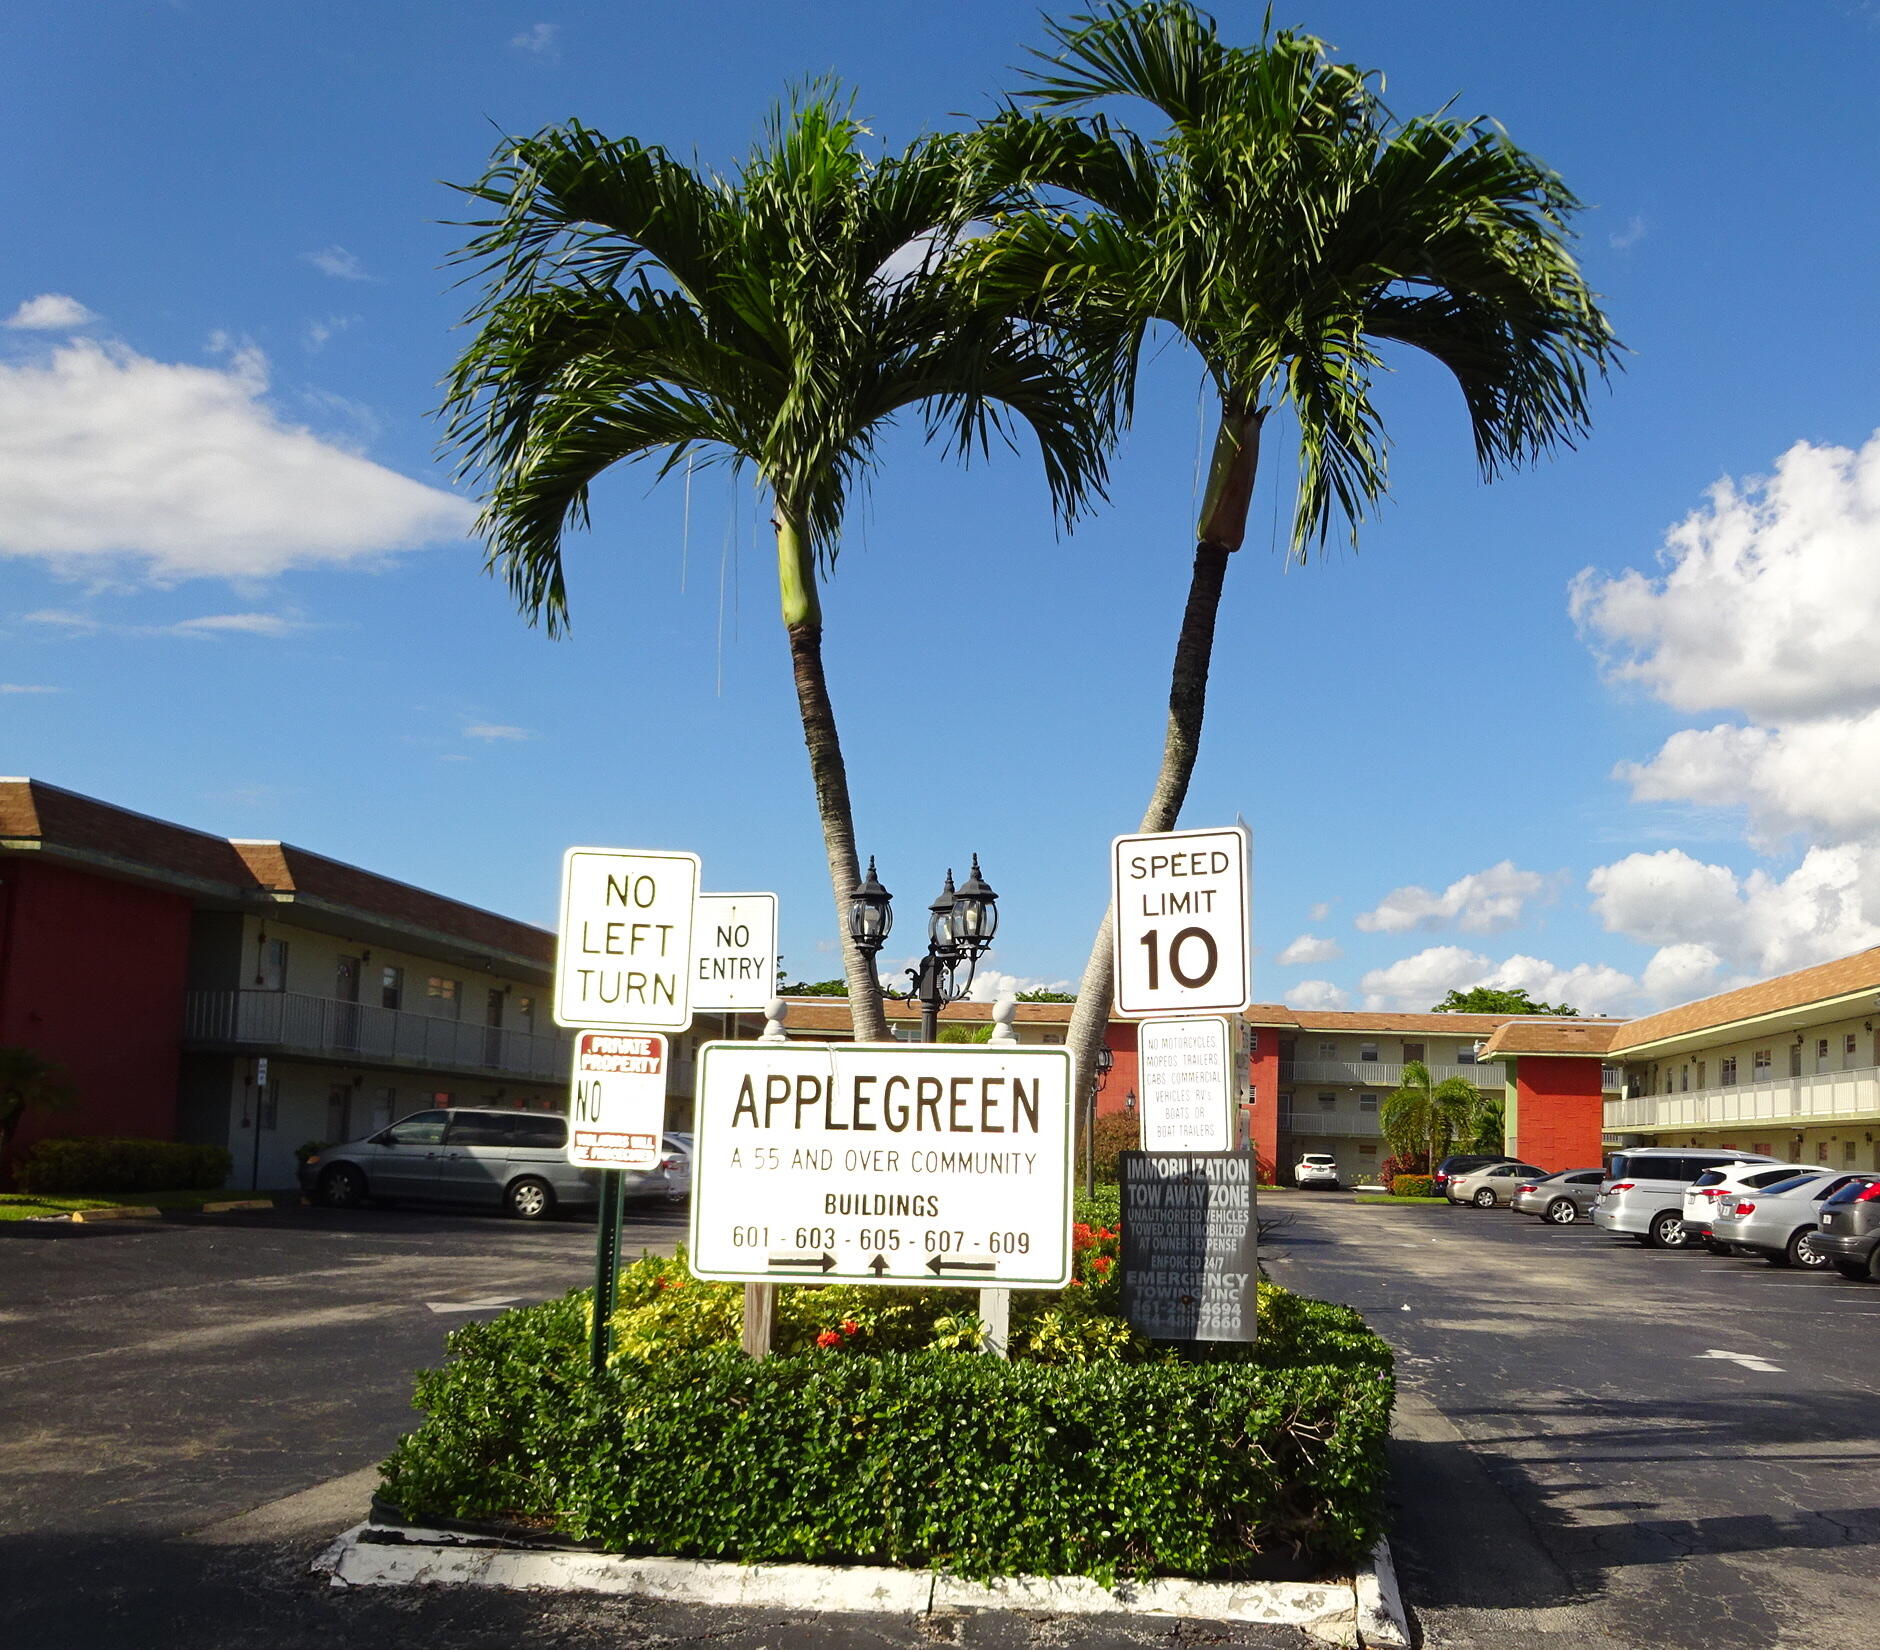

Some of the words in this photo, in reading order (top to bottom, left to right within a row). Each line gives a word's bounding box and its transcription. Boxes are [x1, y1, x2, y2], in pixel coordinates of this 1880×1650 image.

[1131, 851, 1229, 880] SPEED
[606, 874, 656, 908] NO
[1143, 889, 1217, 917] LIMIT
[582, 921, 674, 957] LEFT
[716, 925, 749, 948] NO
[699, 957, 765, 980] ENTRY
[1140, 926, 1218, 989] 10
[577, 969, 675, 1006] TURN
[1148, 1038, 1159, 1051] NO
[1161, 1036, 1216, 1050] MOTORCYCLES
[581, 1054, 661, 1074] PROPERTY
[1146, 1055, 1178, 1067] MOPEDS
[1146, 1073, 1166, 1085] CABS
[1171, 1071, 1221, 1085] COMMERCIAL
[576, 1080, 602, 1122] NO
[731, 1073, 1039, 1133] APPLEGREEN
[1155, 1089, 1191, 1103] VEHICLES
[1165, 1107, 1190, 1120] BOATS
[1194, 1106, 1205, 1119] OR
[1157, 1124, 1175, 1138] BOAT
[1179, 1124, 1215, 1137] TRAILERS
[730, 1147, 742, 1169] A
[754, 1148, 779, 1170] 55
[791, 1148, 833, 1171] AND
[845, 1149, 899, 1172] OVER
[911, 1150, 1037, 1174] COMMUNITY
[1127, 1158, 1249, 1180] IMMOBILIZATION
[824, 1194, 939, 1217] BUILDINGS
[1127, 1184, 1161, 1207] TOW
[1164, 1184, 1206, 1208] AWAY
[1208, 1184, 1250, 1208] ZONE
[1127, 1208, 1202, 1221] UNAUTHORIZED
[1204, 1209, 1249, 1223] VEHICLES
[733, 1226, 769, 1248] 601
[795, 1227, 836, 1249] 603
[860, 1229, 900, 1251] 605
[924, 1230, 965, 1253] 607
[989, 1232, 1030, 1254] 609
[1130, 1223, 1164, 1237] TOWED
[1166, 1223, 1179, 1237] OR
[1181, 1223, 1246, 1237] IMMOBILIZED
[1139, 1237, 1150, 1249] AT
[1195, 1238, 1237, 1252] EXPENSE
[1151, 1255, 1201, 1269] ENFORCED
[1204, 1256, 1225, 1270] 24/7
[1126, 1271, 1249, 1287] EMERGENCY
[1211, 1288, 1240, 1300] INC
